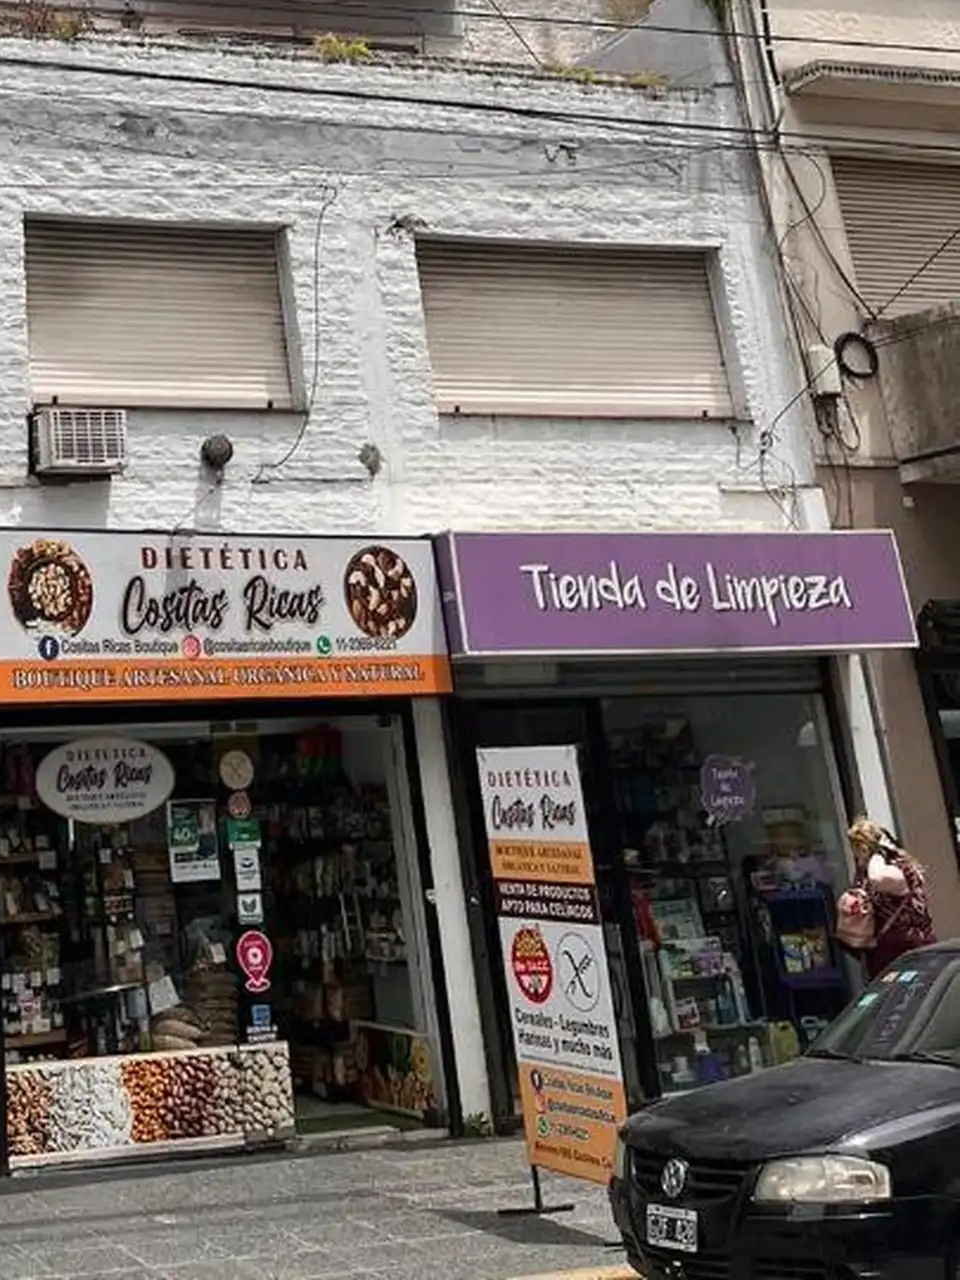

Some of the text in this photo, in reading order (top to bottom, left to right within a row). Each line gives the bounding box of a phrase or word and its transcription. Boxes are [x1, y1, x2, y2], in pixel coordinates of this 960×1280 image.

[141, 542, 307, 570] DIETÉTICA
[123, 575, 324, 634] Cositas Ricas
[520, 560, 854, 627] Tienda de Limpieza
[13, 667, 113, 691] BOUTIQUE
[122, 666, 226, 688] ARTESANAL
[341, 662, 424, 682] NATURAL
